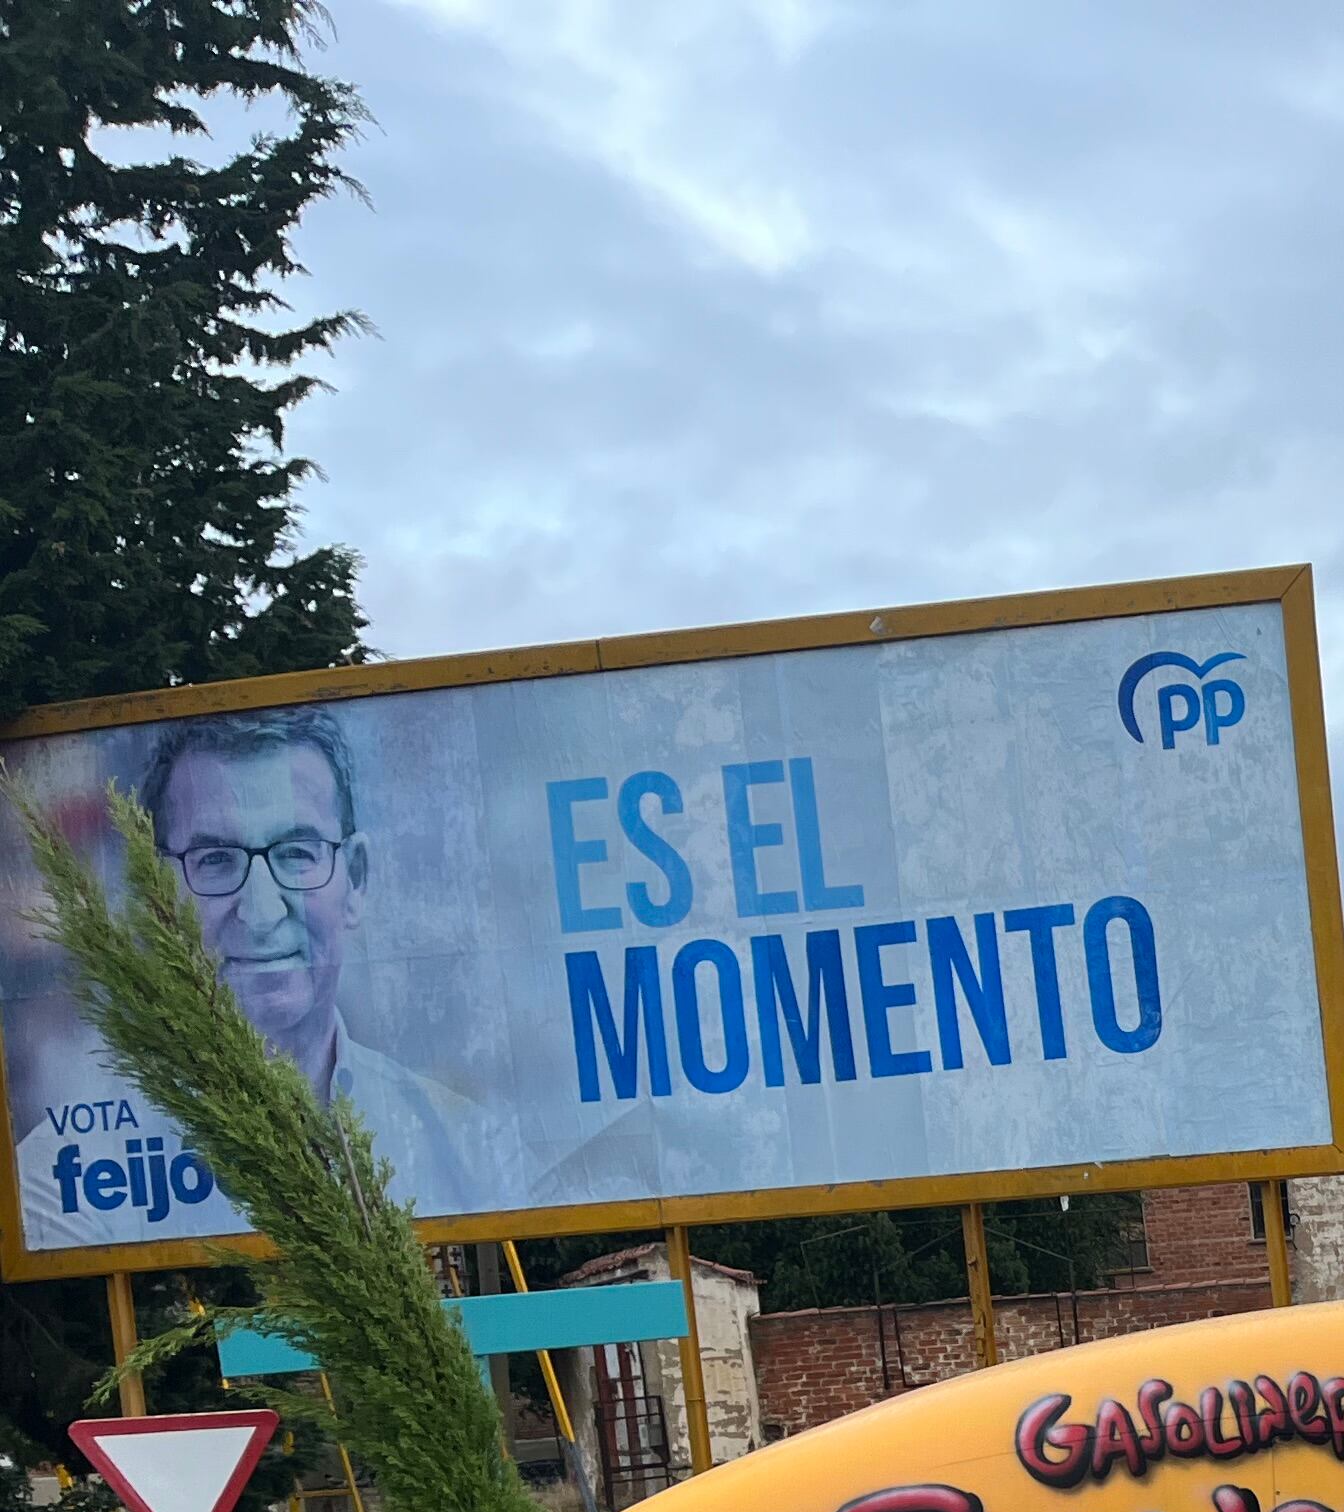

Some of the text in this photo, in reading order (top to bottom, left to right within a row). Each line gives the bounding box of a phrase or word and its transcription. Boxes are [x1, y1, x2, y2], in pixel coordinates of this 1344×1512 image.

[545, 756, 865, 935] ES EL
[563, 895, 1164, 1103] MOMENTO
[46, 1099, 139, 1136] VOTA
